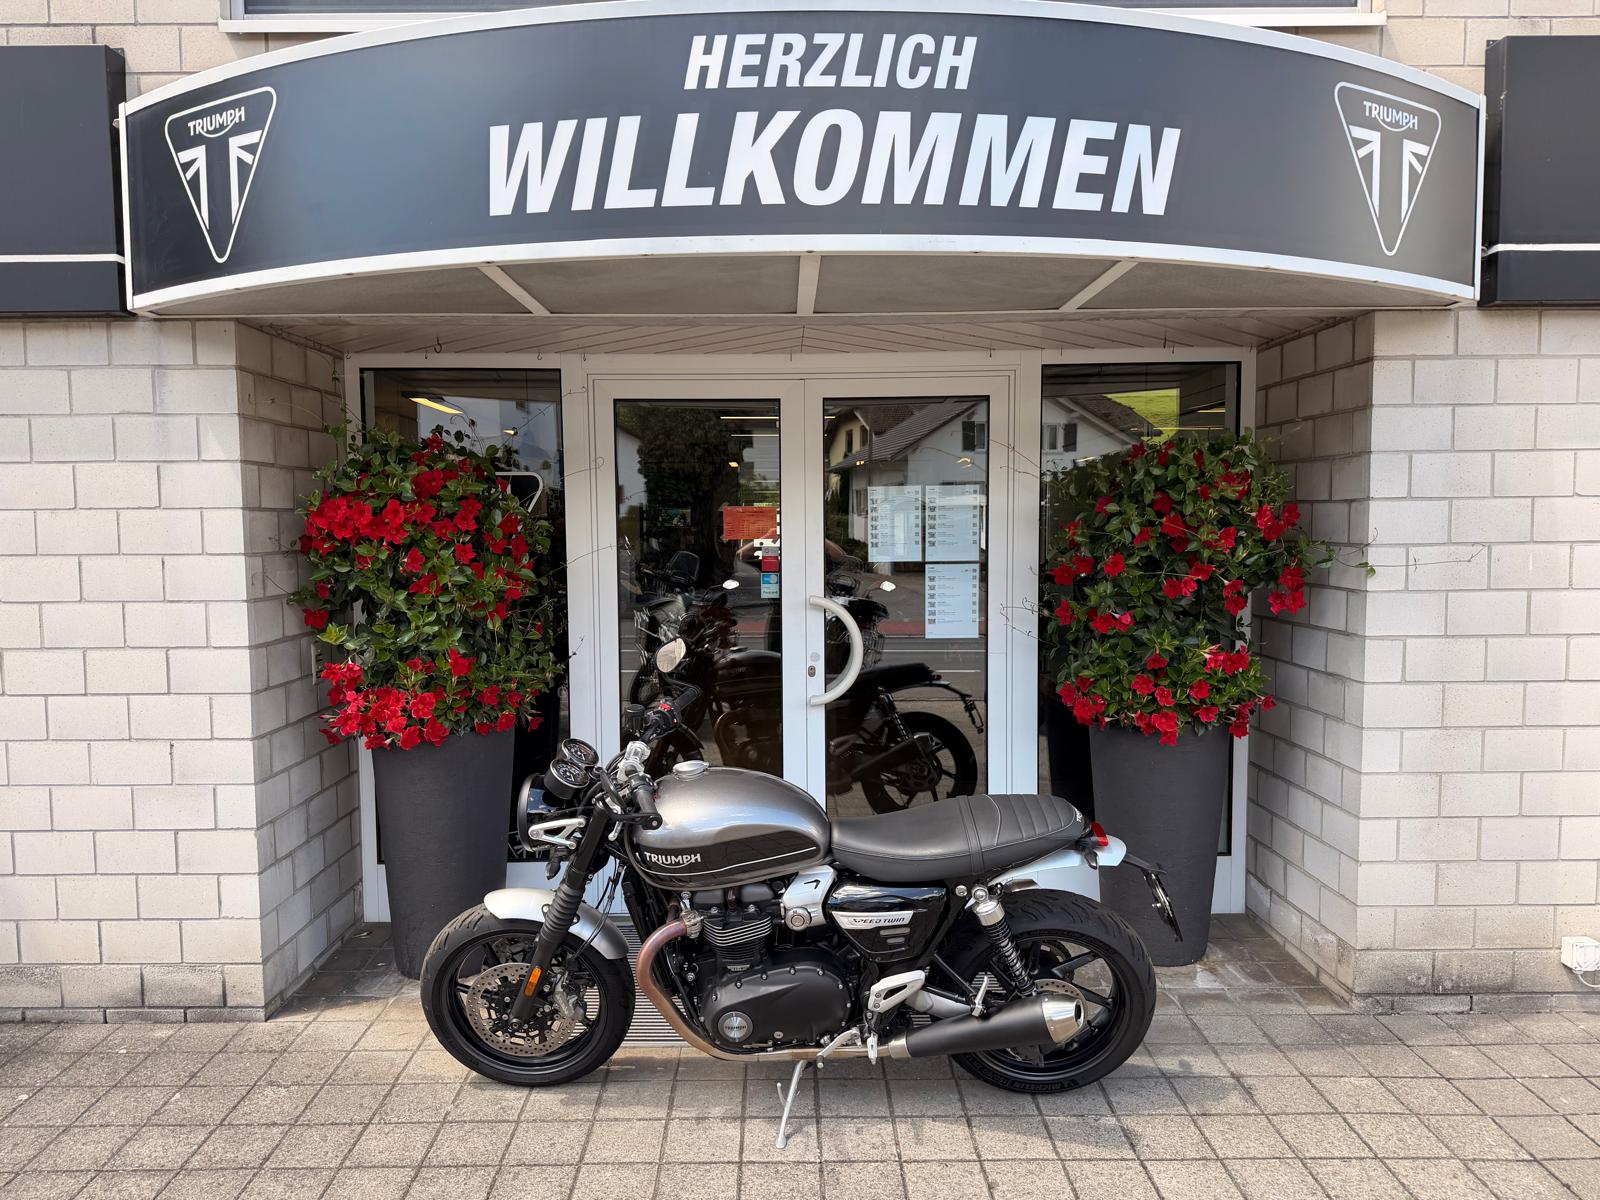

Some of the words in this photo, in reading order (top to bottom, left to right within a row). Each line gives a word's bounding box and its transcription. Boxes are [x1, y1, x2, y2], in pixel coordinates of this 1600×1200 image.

[683, 32, 978, 90] HERZLICH
[188, 106, 245, 137] TRIUMPH
[1363, 101, 1418, 131] TRIUMPH
[488, 108, 1182, 217] WILLKOMMEN
[644, 851, 701, 867] TRIUMPH
